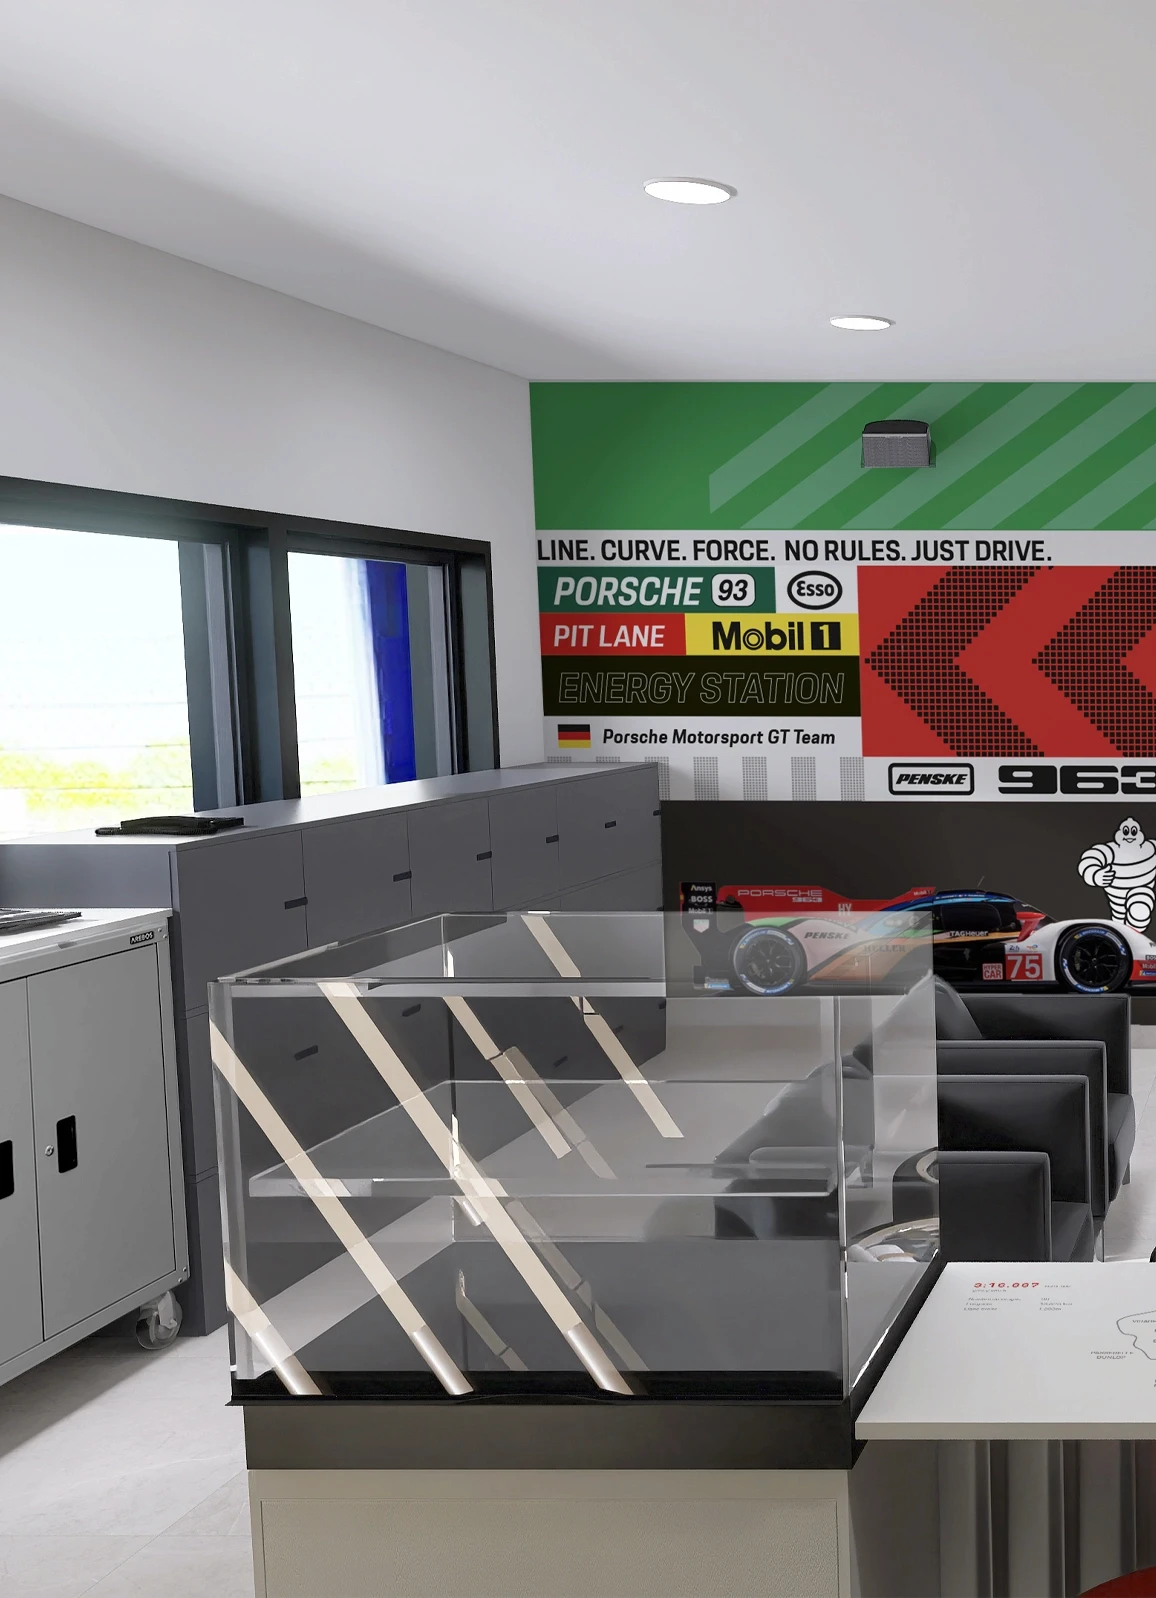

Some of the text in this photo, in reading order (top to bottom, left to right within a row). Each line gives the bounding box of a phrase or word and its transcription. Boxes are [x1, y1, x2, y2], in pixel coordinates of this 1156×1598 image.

[537, 539, 1051, 562] LINE. CURVE. FORCE. NO RULES. JUST DRIVE.
[554, 577, 748, 606] PORSCHE 93
[797, 580, 833, 597] Esso
[553, 624, 665, 648] PIT LANE
[712, 621, 804, 650] Mobil
[558, 672, 844, 704] ENERGY STATION
[603, 729, 835, 748] Porsche Motorsport GT Team
[896, 773, 968, 785] PENSKE
[690, 895, 713, 903] BOSS
[738, 889, 823, 897] PORSCHE
[838, 903, 852, 916] HY
[984, 970, 1002, 978] CAR
[1007, 955, 1041, 978] 75
